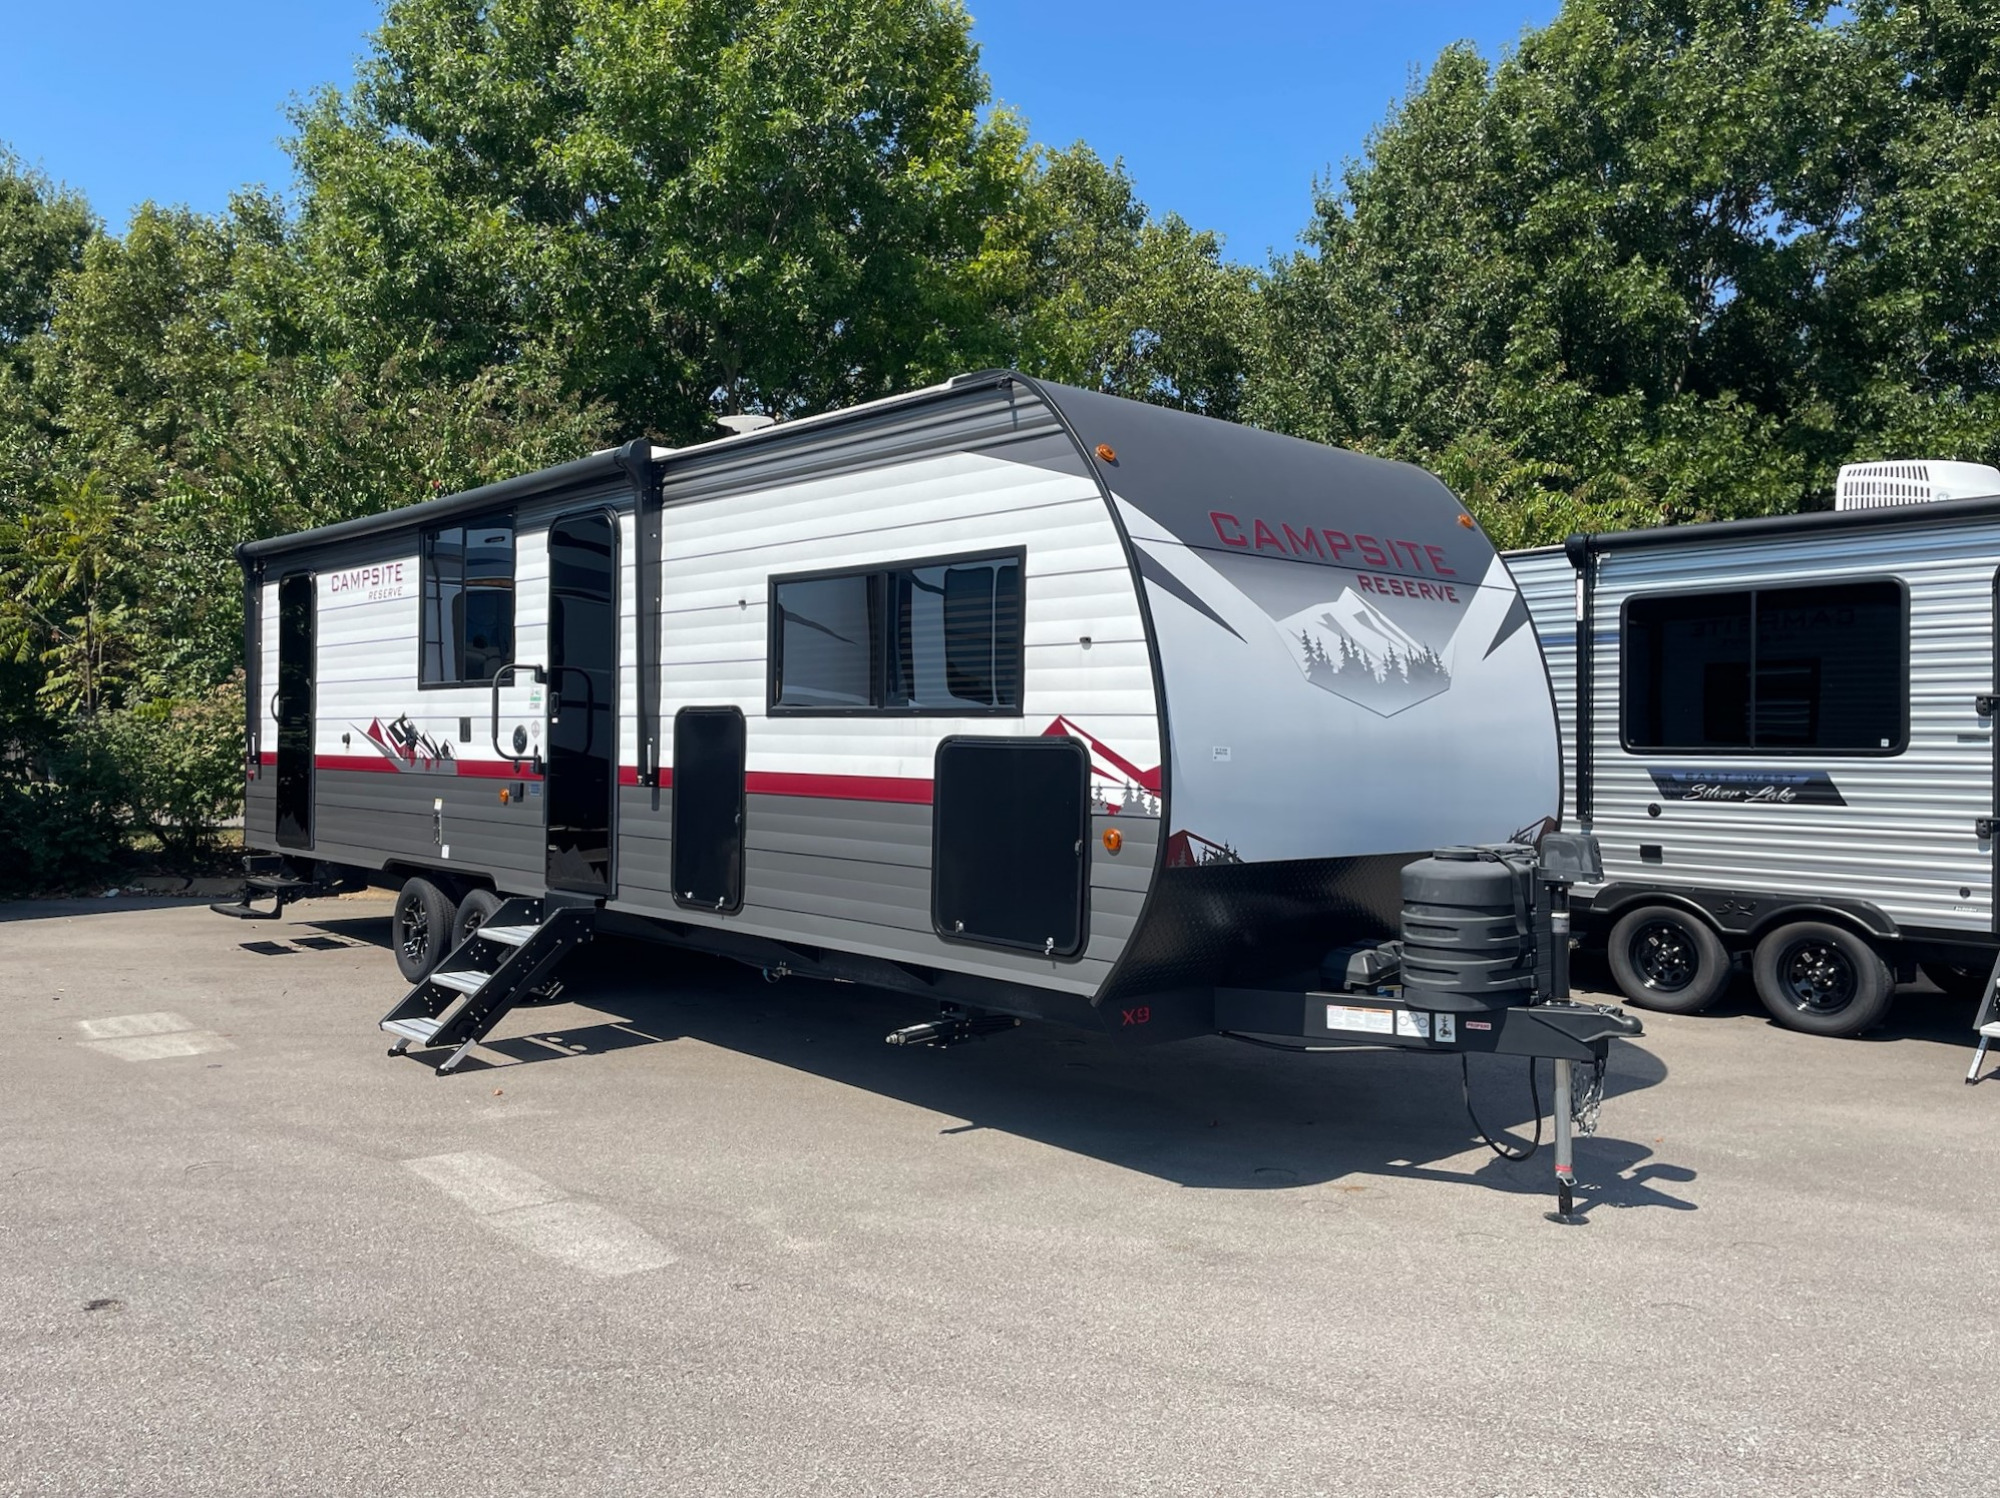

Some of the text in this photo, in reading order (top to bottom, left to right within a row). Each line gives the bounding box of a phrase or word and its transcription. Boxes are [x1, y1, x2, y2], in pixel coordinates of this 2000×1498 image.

[1208, 511, 1457, 576] CAMPSITE
[331, 563, 403, 592] CAMPSITE
[368, 586, 403, 600] RESERVE
[1357, 574, 1460, 603] RESERVE
[1685, 772, 1732, 781] EAST
[1746, 773, 1797, 782] WEST
[1682, 783, 1797, 802] Silver Lake
[1122, 1006, 1150, 1026] X9
